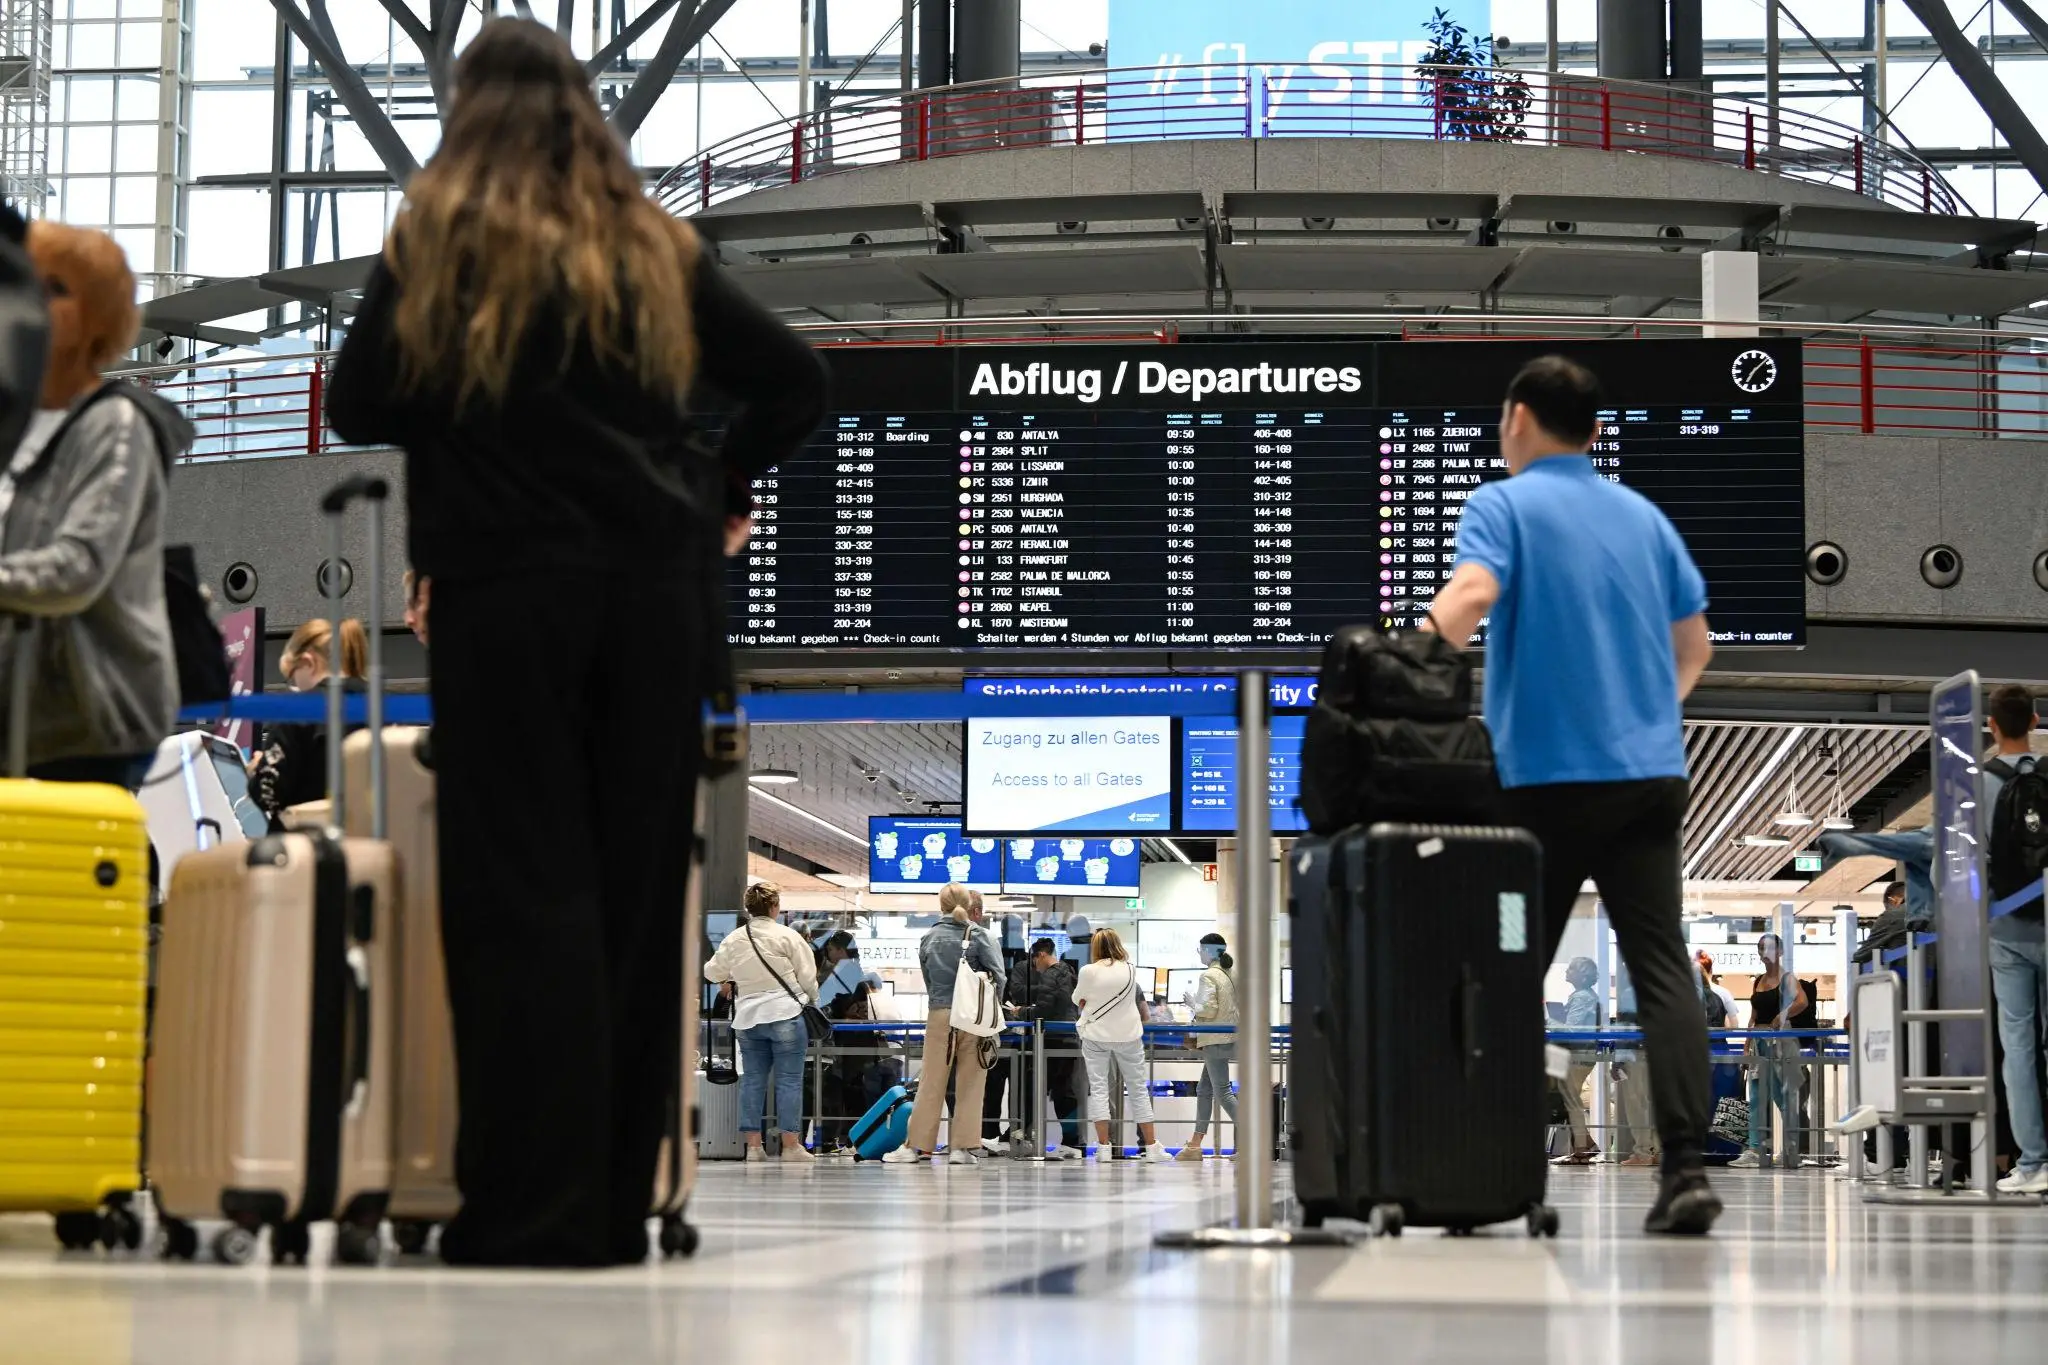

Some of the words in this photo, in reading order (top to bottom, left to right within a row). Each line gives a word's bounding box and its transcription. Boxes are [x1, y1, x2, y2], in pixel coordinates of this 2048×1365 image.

[969, 361, 1102, 402] Abflug
[1111, 361, 1129, 395] /
[1138, 361, 1362, 402] Departures
[973, 430, 986, 441] 4M
[1020, 430, 1060, 440] ANTALYA
[1166, 429, 1195, 439] 09:50
[1393, 427, 1406, 438] LX
[1441, 426, 1482, 437] ZUERICH
[1679, 424, 1720, 435] 313-319
[836, 432, 875, 442] 310-312
[886, 431, 930, 443] Boarding
[836, 447, 875, 457] 160-169
[973, 446, 986, 456] EW
[1020, 445, 1049, 456] SPLIT
[1166, 445, 1195, 455] 09:55
[1254, 444, 1292, 454] 160-169
[1393, 443, 1406, 453] EW
[1442, 442, 1471, 453] TIVAT
[1591, 441, 1620, 452] 11:15
[835, 463, 874, 473] 406-409
[972, 461, 986, 472] EW
[1020, 461, 1065, 472] LISSABON
[1166, 460, 1195, 470] 10:00
[1253, 459, 1292, 470] 144-148
[1393, 458, 1406, 469] EW
[1442, 458, 1471, 468] PALMA
[1474, 458, 1487, 468] DE
[1591, 457, 1620, 467] 11:15
[835, 478, 874, 488] 412-415
[972, 477, 986, 487] PC
[1022, 476, 1049, 487] IZMIR
[1166, 476, 1195, 486] 10:00
[1253, 475, 1292, 485] 402-405
[1393, 474, 1406, 485] TK
[1442, 474, 1482, 484] ANTALYA
[835, 494, 874, 504] 313-319
[972, 493, 986, 503] SM
[1020, 492, 1064, 503] HURGHADA
[1166, 492, 1195, 502] 10:15
[1253, 491, 1292, 502] 310-312
[1393, 490, 1406, 501] EW
[750, 510, 778, 520] 08:25
[835, 509, 874, 519] 155-158
[972, 508, 985, 518] EW
[1020, 508, 1064, 518] VALENCIA
[1166, 507, 1195, 518] 10:35
[1254, 507, 1292, 517] 144-148
[1393, 506, 1406, 516] PC
[750, 525, 778, 535] 08:30
[835, 525, 873, 535] 207-209
[972, 524, 985, 534] PC
[1020, 523, 1059, 534] ANTALYA
[1166, 523, 1195, 533] 10:40
[1393, 522, 1406, 532] EW
[749, 541, 777, 551] 08:40
[834, 540, 873, 550] 330-332
[972, 539, 985, 550] EW
[1019, 539, 1069, 549] HERAKLION
[1166, 539, 1195, 549] 10:45
[1253, 538, 1292, 548] 144-148
[1393, 537, 1406, 548] PC
[749, 556, 777, 566] 08:55
[834, 556, 873, 566] 313-319
[971, 555, 985, 565] LH
[1019, 555, 1069, 565] FRANKFURT
[1166, 554, 1194, 564] 10:45
[1253, 554, 1292, 564] 313-319
[1393, 553, 1406, 564] EW
[748, 572, 777, 582] 09:05
[834, 572, 873, 582] 337-339
[971, 571, 985, 581] EW
[1019, 571, 1048, 581] PALMA
[1050, 571, 1063, 581] DE
[1066, 570, 1111, 581] MALLORCA
[1166, 570, 1194, 581] 10:55
[1254, 570, 1292, 580] 160-169
[1393, 569, 1406, 580] EW
[748, 587, 777, 598] 09:30
[834, 587, 872, 597] 150-152
[971, 586, 985, 597] TK
[1021, 586, 1063, 597] ISTANBUL
[1166, 586, 1194, 596] 10:55
[1253, 586, 1292, 596] 135-138
[1393, 585, 1406, 596] EW
[748, 603, 776, 613] 09:35
[833, 603, 872, 613] 313-319
[971, 602, 985, 612] EW
[1019, 602, 1053, 612] NEAPEL
[1166, 602, 1194, 612] 11:00
[1253, 601, 1292, 612] 160-169
[748, 618, 776, 629] 09:40
[833, 618, 872, 629] 200-204
[971, 618, 985, 628] KL
[1019, 617, 1069, 628] AMSTERDAM
[1166, 617, 1194, 627] 11:00
[1252, 617, 1292, 627] 200-204
[1393, 617, 1406, 627] VY
[727, 634, 756, 644] bflug
[760, 633, 796, 643] bekannt
[801, 634, 839, 645] gegeben
[863, 633, 906, 643] Check-in
[977, 633, 1019, 643] Schalter
[1024, 633, 1057, 643] werden
[1060, 633, 1067, 643] 4
[1071, 633, 1110, 643] Stunden
[1114, 635, 1129, 643] vor
[1134, 633, 1167, 644] Abflug
[1171, 633, 1209, 643] bekannt
[1213, 633, 1252, 643] gegeben
[1276, 632, 1321, 643] Check-in
[1706, 631, 1751, 641] Check-in
[1754, 631, 1793, 641] counter
[982, 731, 1042, 749] Zugang
[1047, 734, 1065, 745] zu
[1071, 731, 1108, 745] allen
[1113, 730, 1161, 745] Gates
[991, 772, 1049, 786] Access
[1054, 774, 1068, 786] to
[1073, 773, 1091, 786] all
[1096, 772, 1143, 786] Gates
[858, 947, 911, 959] RAVEL
